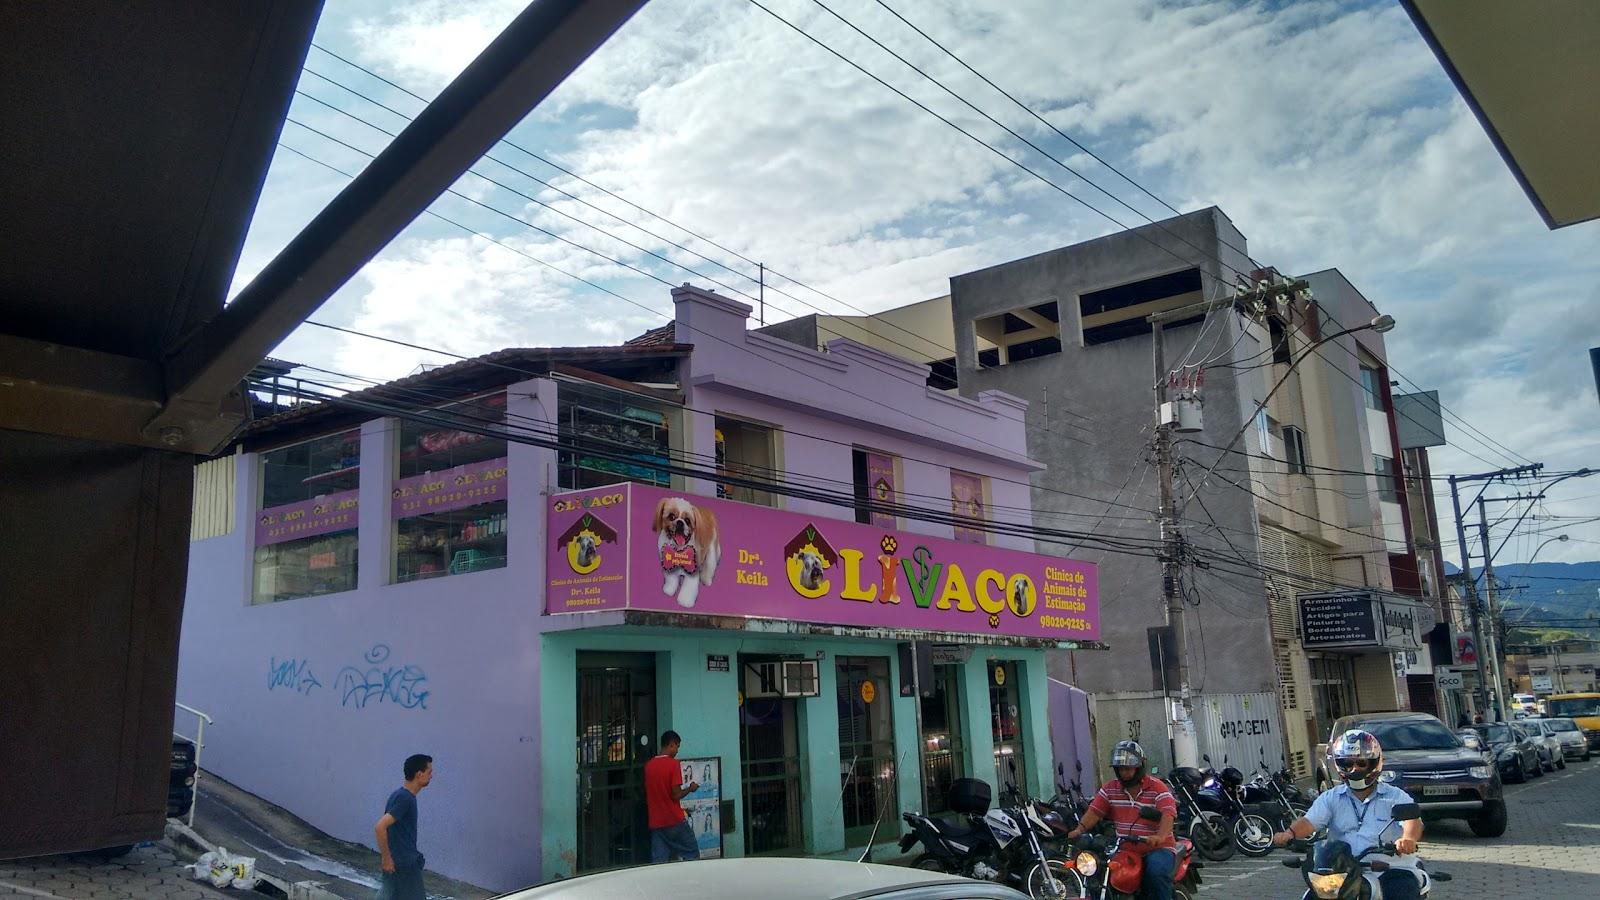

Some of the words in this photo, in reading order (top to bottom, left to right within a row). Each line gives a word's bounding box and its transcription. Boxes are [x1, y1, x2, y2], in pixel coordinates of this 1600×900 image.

[736, 569, 769, 587] Keila
[1074, 571, 1084, 584] de
[584, 586, 601, 596] Keila
[1043, 580, 1077, 597] Animais
[1077, 586, 1087, 598] de
[1045, 595, 1086, 614] Estimação
[1304, 597, 1358, 605] Armarinhos
[1040, 615, 1085, 631] 98020-9225
[1309, 633, 1366, 641] Artesanatos
[1220, 718, 1270, 739] GARAGEM
